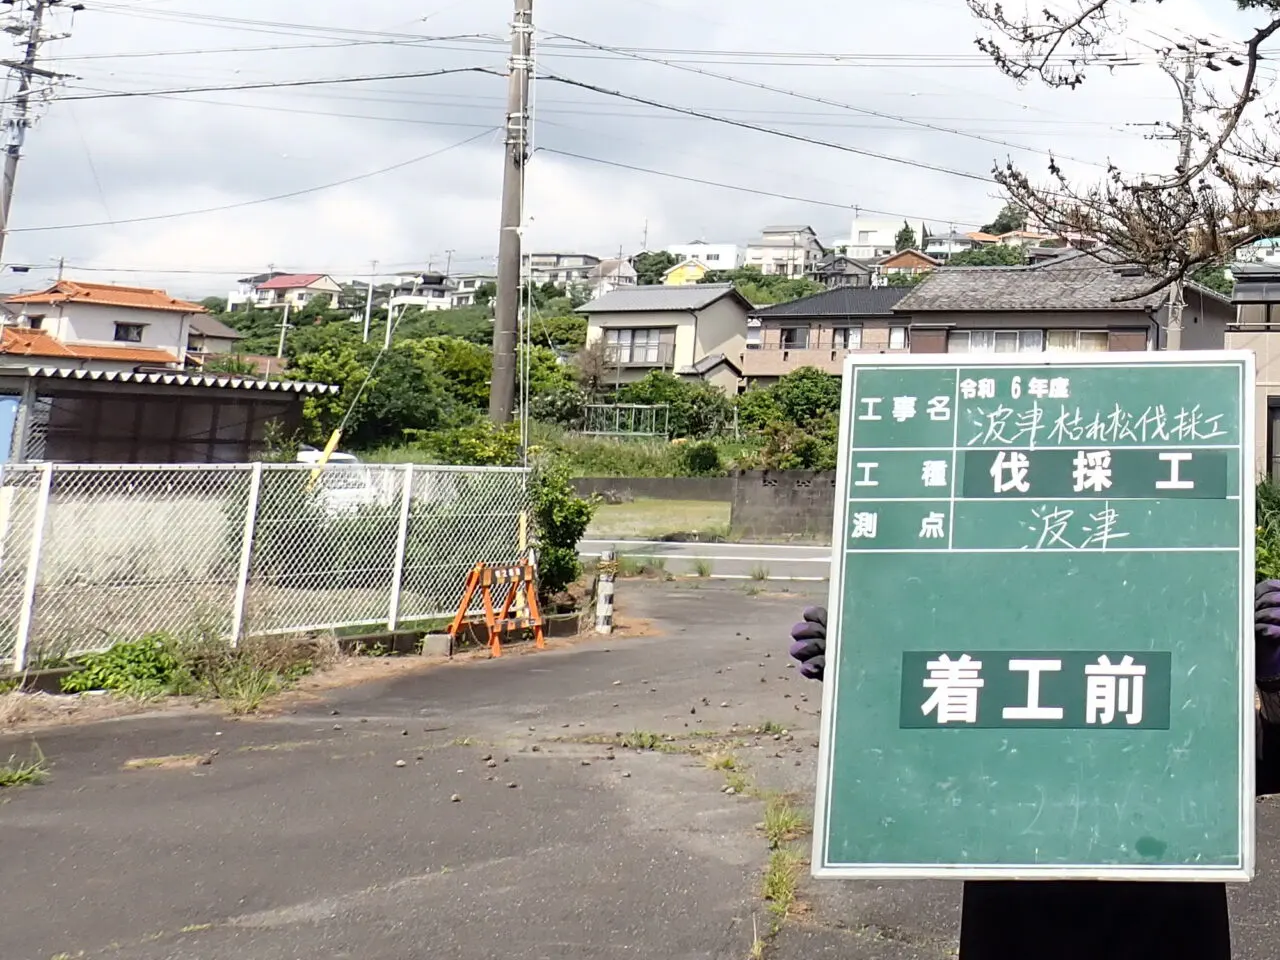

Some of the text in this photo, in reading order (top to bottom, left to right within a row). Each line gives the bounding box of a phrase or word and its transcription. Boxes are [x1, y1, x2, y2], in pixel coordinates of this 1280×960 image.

[859, 396, 951, 422] 工事名
[855, 460, 947, 487] 工種
[990, 451, 1195, 493] 伐採工
[851, 511, 945, 539] 測点
[1020, 501, 1130, 551] 波津
[921, 654, 1147, 724] 着工前
